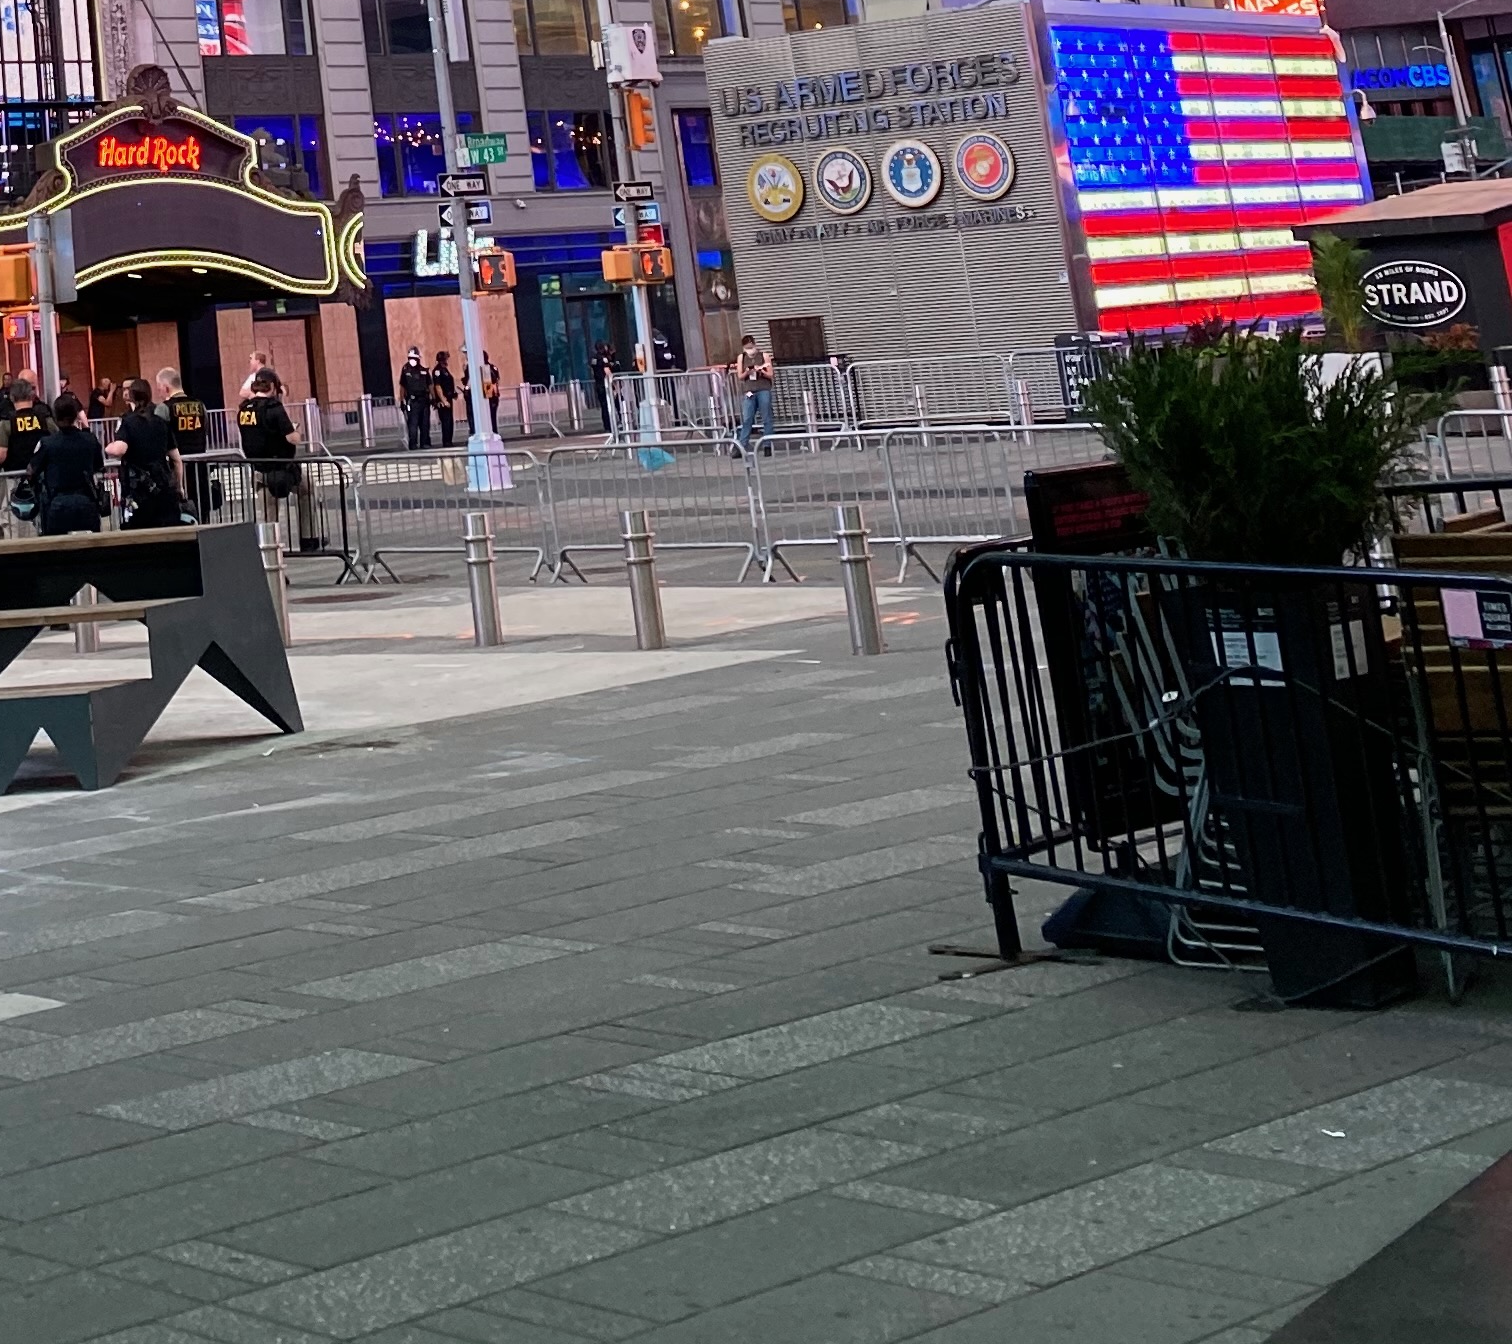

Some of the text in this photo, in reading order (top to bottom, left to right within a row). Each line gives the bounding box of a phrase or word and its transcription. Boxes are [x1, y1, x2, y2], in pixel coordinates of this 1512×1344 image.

[774, 69, 885, 112] ARMED
[890, 52, 1020, 95] FORCES
[738, 92, 1008, 147] RECRUITING STATION
[99, 135, 200, 172] Hard Rock
[470, 149, 479, 164] W
[483, 147, 495, 163] 43
[446, 180, 480, 190] ONE WAY
[956, 205, 1025, 227] MARINES
[1364, 280, 1459, 306] STRAND
[175, 402, 201, 415] POLICE
[16, 415, 41, 432] DEA
[178, 416, 202, 431] DEA
[238, 411, 258, 426] DEA
